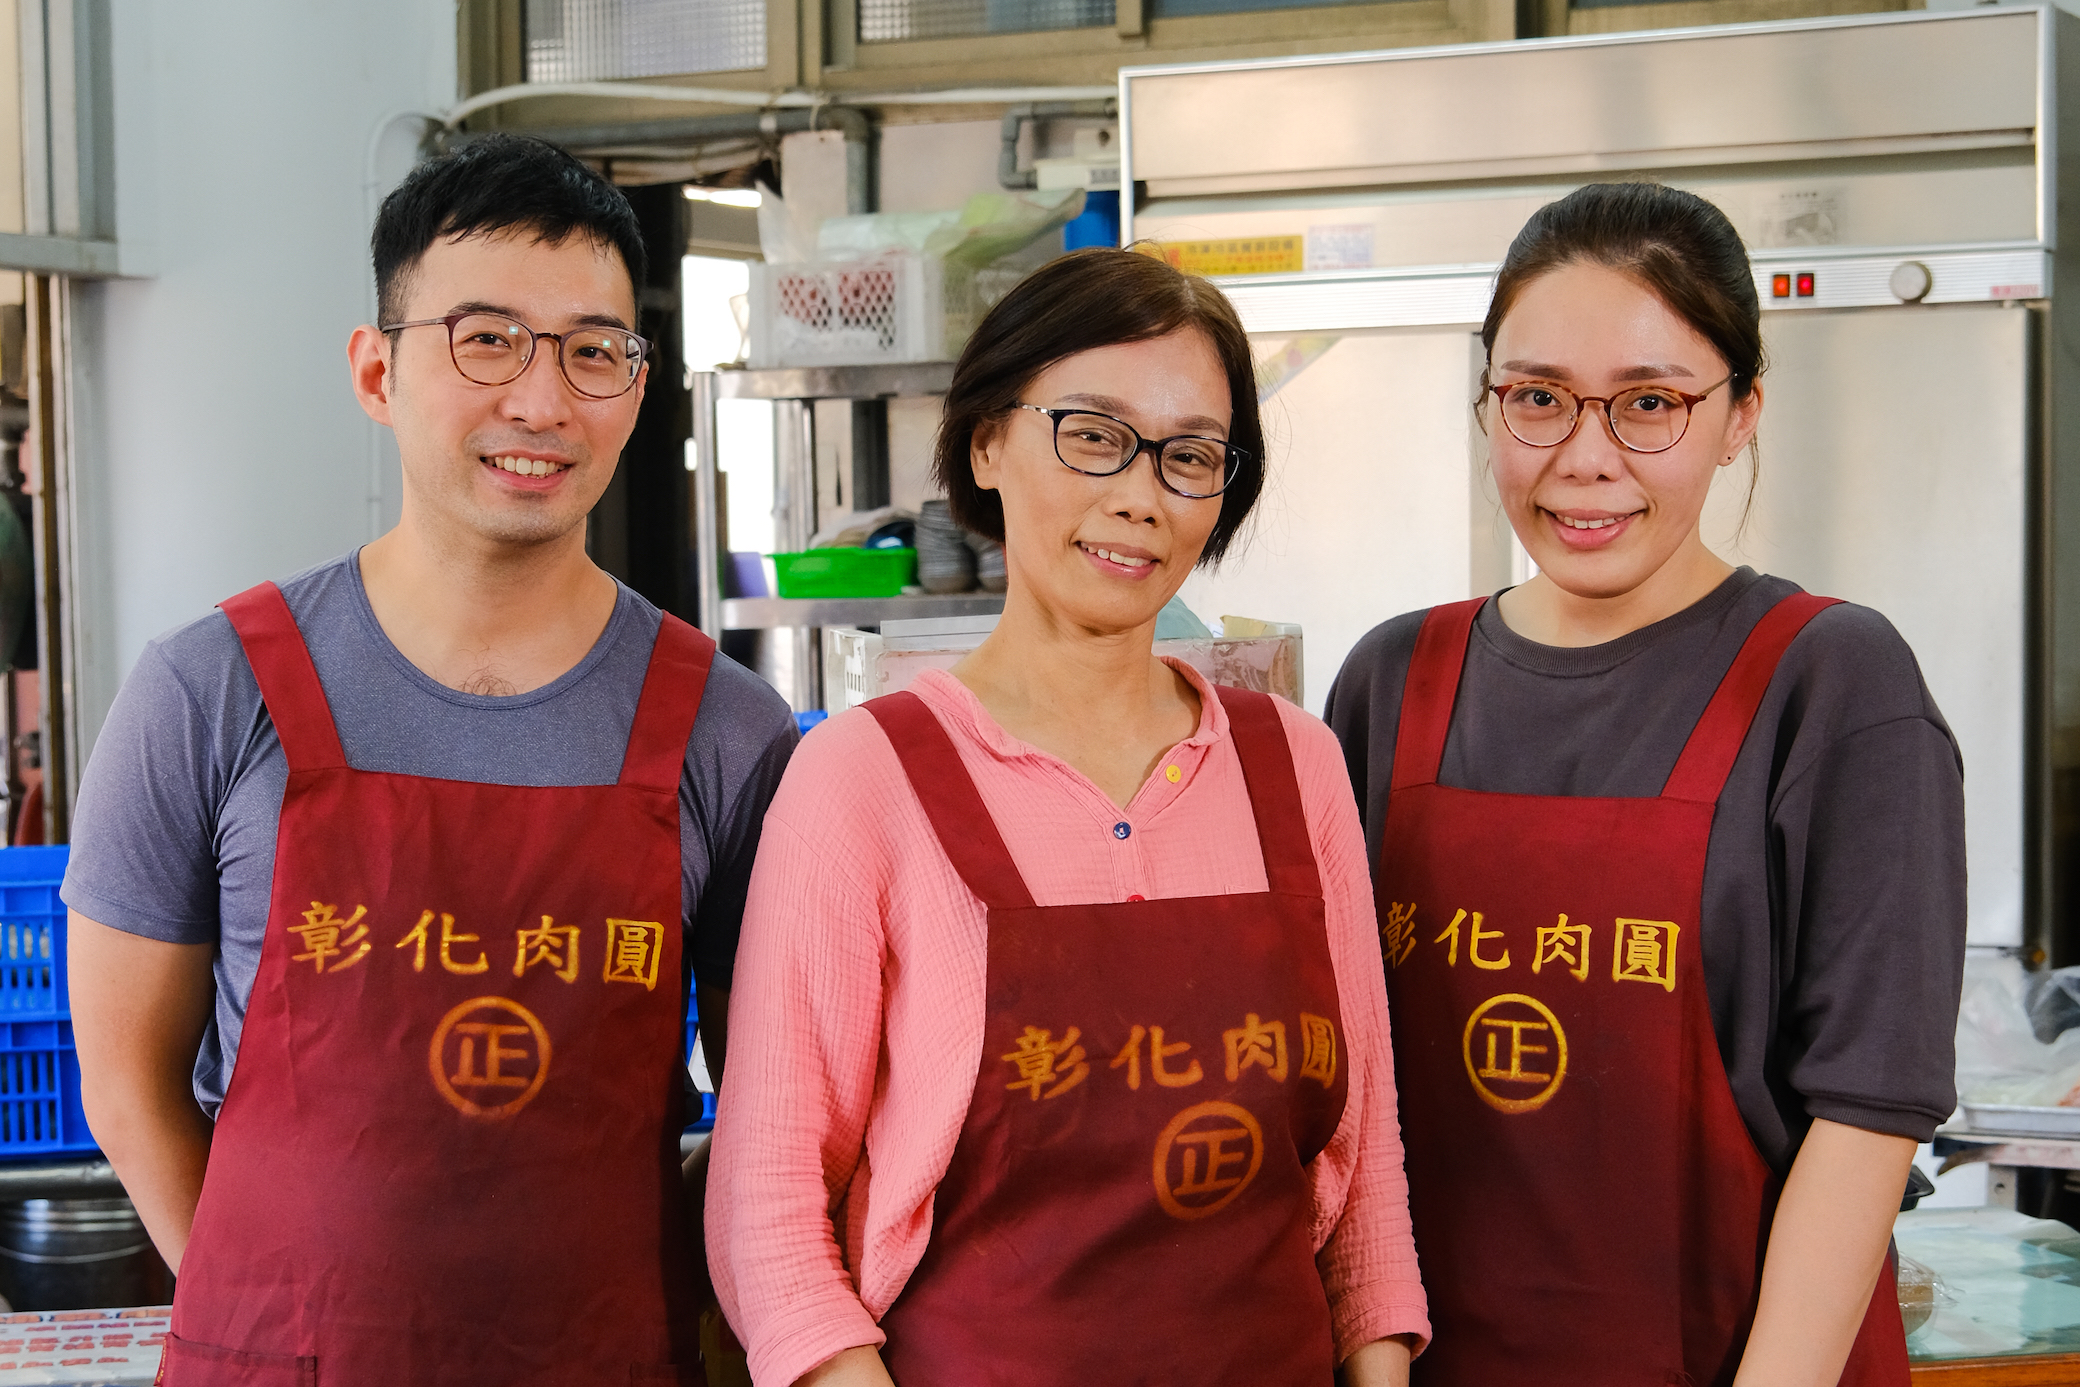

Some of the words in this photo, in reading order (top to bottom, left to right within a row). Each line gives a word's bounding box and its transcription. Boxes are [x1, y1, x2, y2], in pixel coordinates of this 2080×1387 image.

[287, 901, 665, 991] 彰化肉圓
[1382, 901, 1681, 992] 彰化肉圓
[1002, 1012, 1337, 1101] 彰化肉圓
